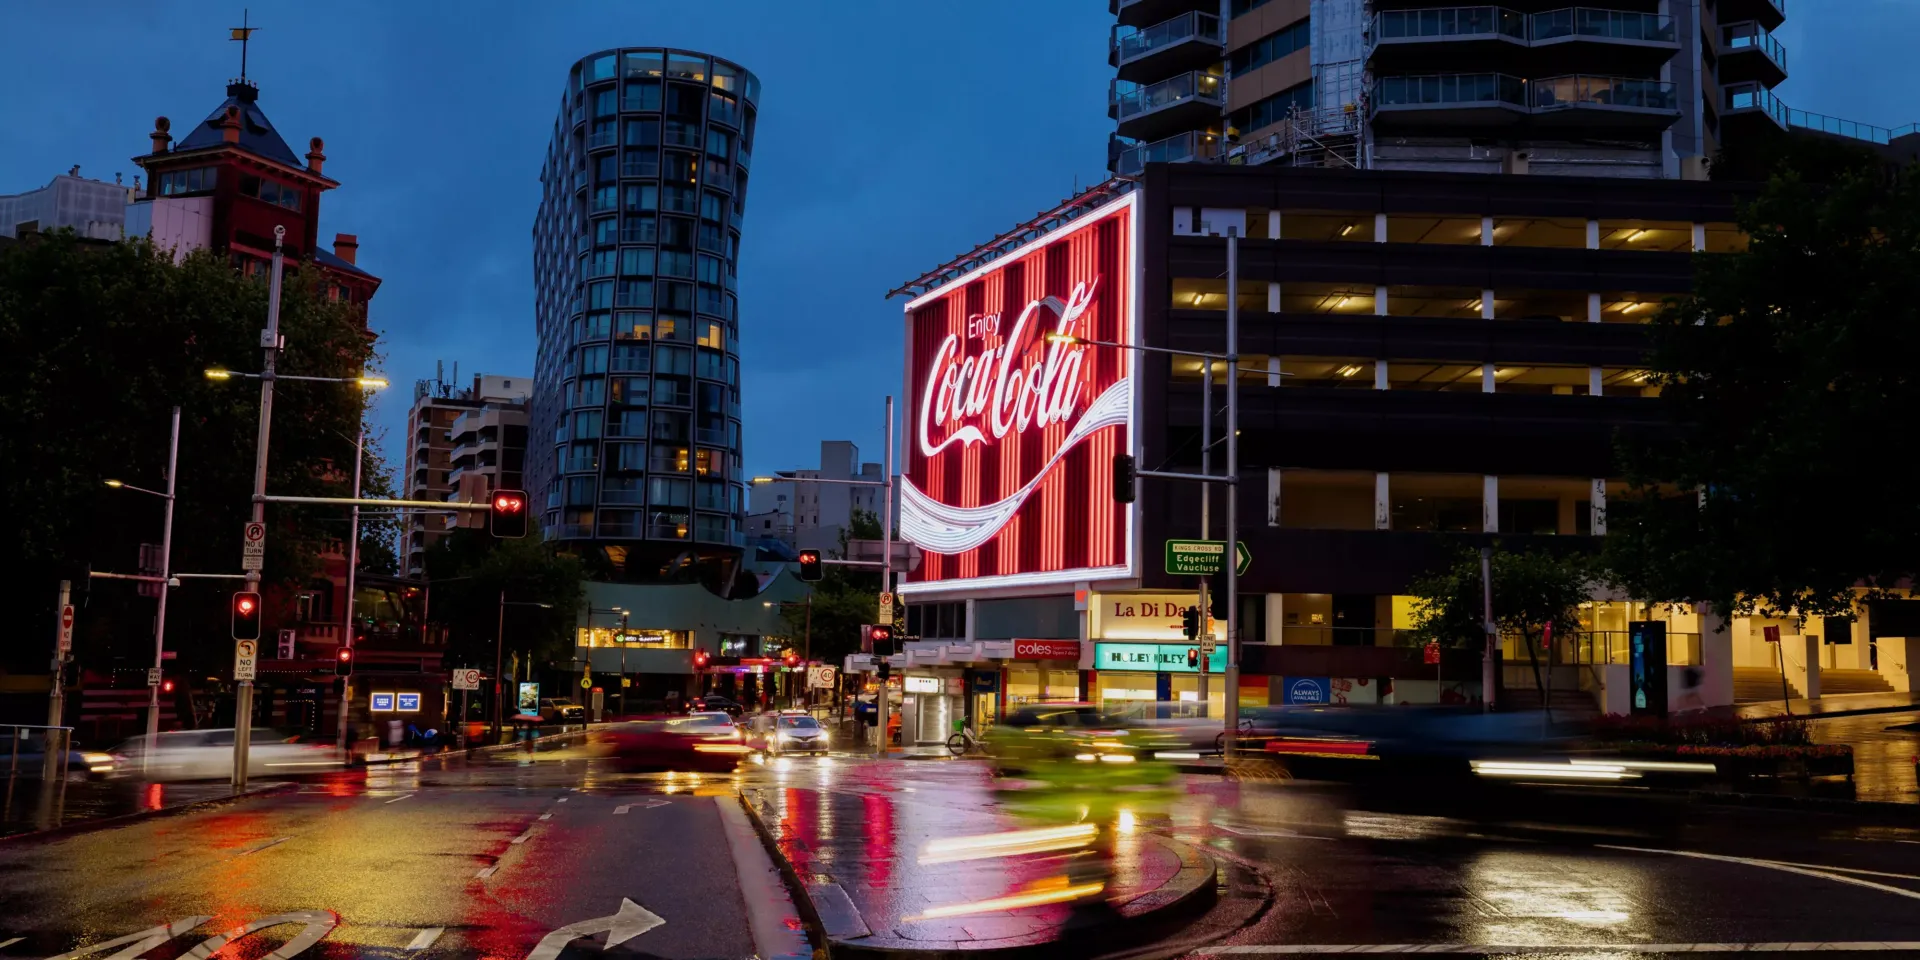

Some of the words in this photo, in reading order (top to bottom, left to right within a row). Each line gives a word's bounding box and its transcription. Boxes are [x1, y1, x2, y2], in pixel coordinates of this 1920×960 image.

[968, 311, 1001, 341] Enjoy
[920, 275, 1099, 457] Coca-Cola
[1176, 554, 1219, 564] Edgecliff
[1176, 563, 1219, 572] Vaucluse
[1114, 602, 1135, 617] La
[1140, 602, 1159, 617] Di
[1017, 642, 1052, 655] coles
[1111, 653, 1150, 662] HOLEY
